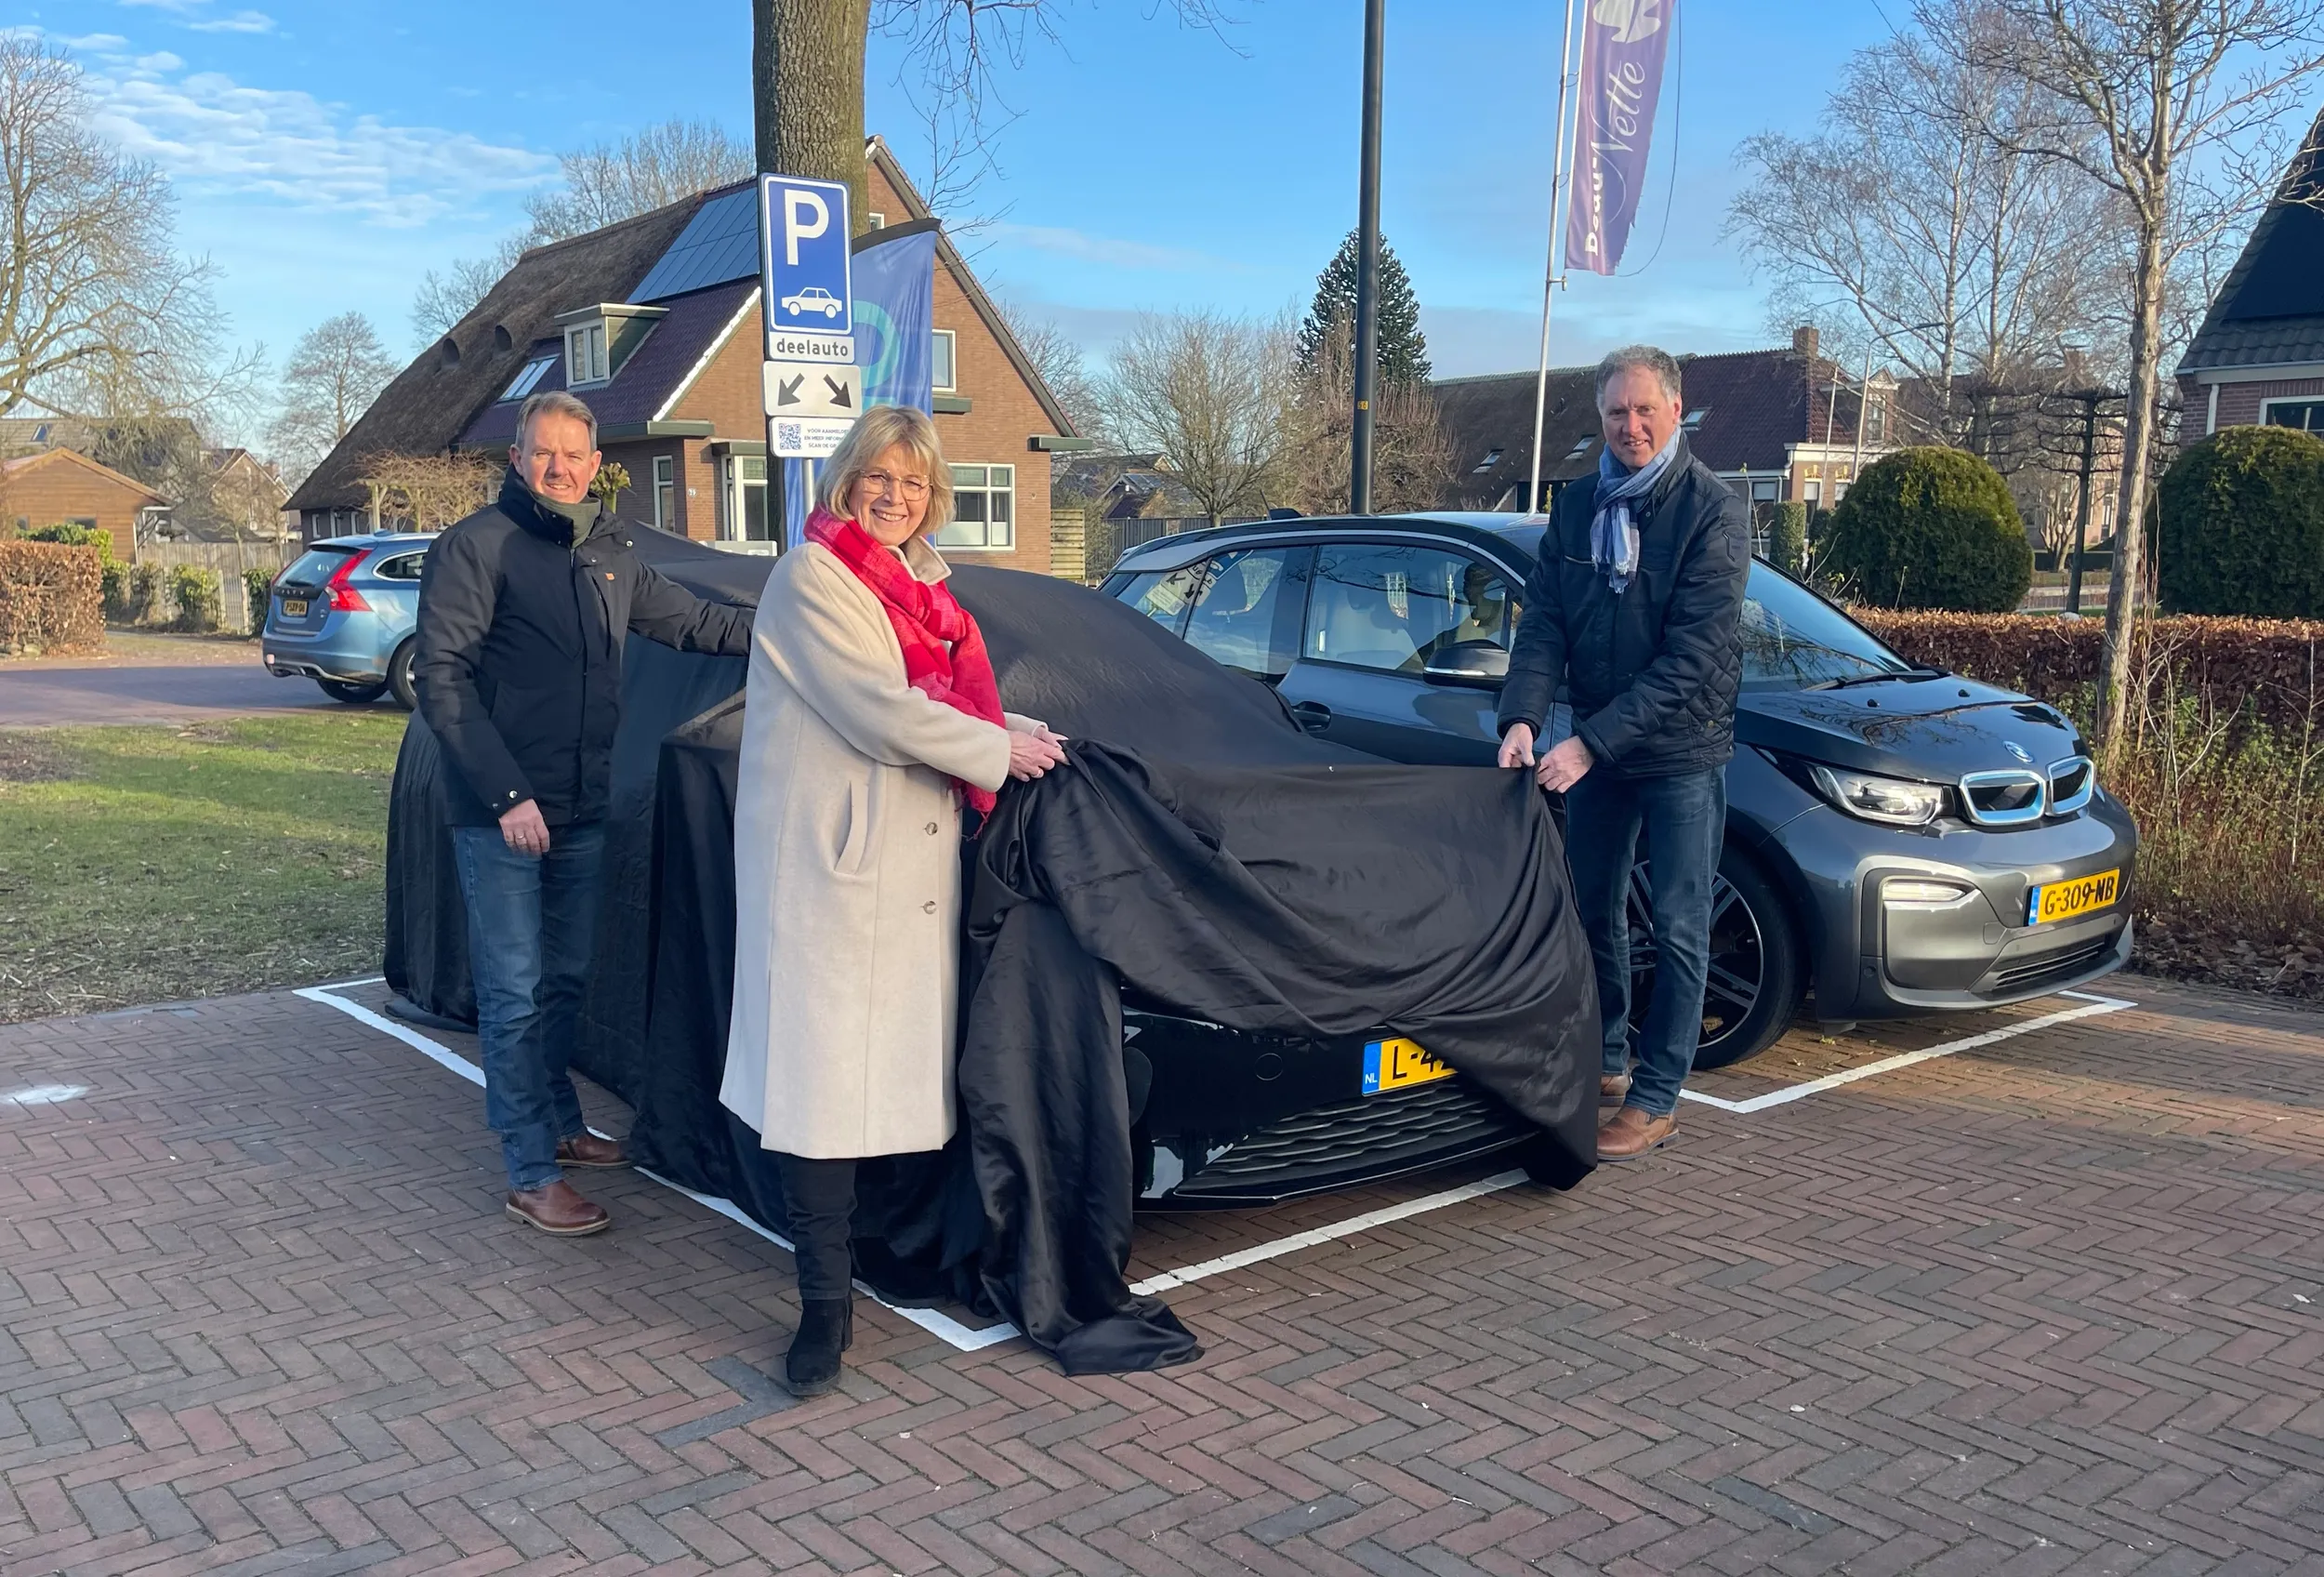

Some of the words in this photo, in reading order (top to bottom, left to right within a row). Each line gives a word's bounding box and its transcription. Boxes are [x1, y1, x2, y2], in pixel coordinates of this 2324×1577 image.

[784, 189, 829, 266] P
[776, 338, 849, 357] deelauto
[2044, 876, 2115, 916] G-309-NB
[1365, 1073, 1378, 1085] NL
